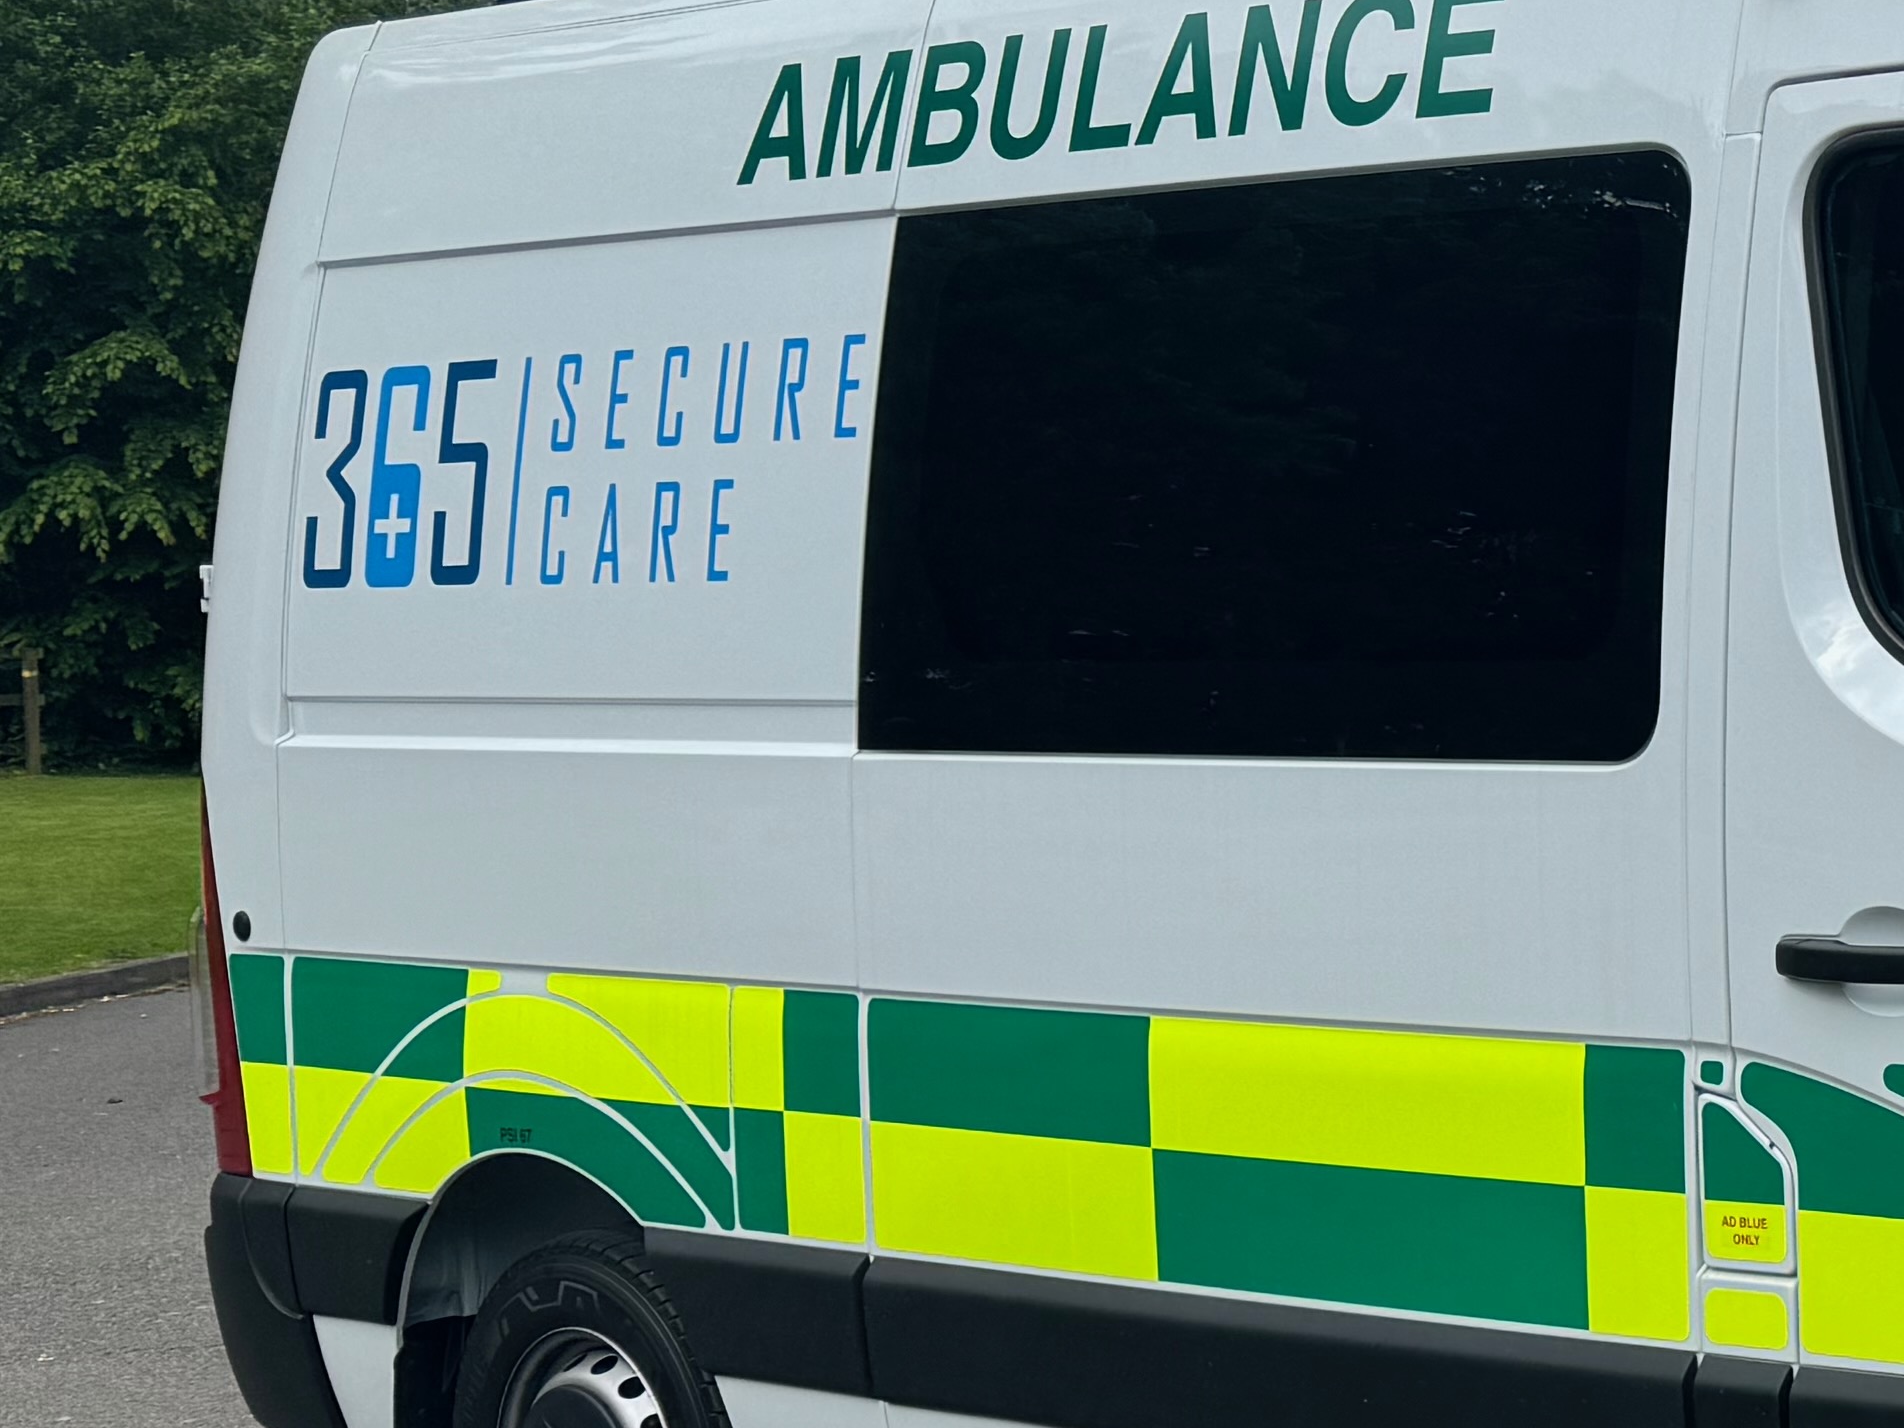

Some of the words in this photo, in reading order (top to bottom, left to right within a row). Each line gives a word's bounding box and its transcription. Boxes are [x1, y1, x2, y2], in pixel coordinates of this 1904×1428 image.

[549, 333, 867, 453] SECURE
[302, 358, 498, 589] 365
[539, 478, 735, 585] CARE
[1721, 1215, 1737, 1228] AD
[1739, 1217, 1768, 1230] BLUE
[1733, 1233, 1760, 1246] ONLY
